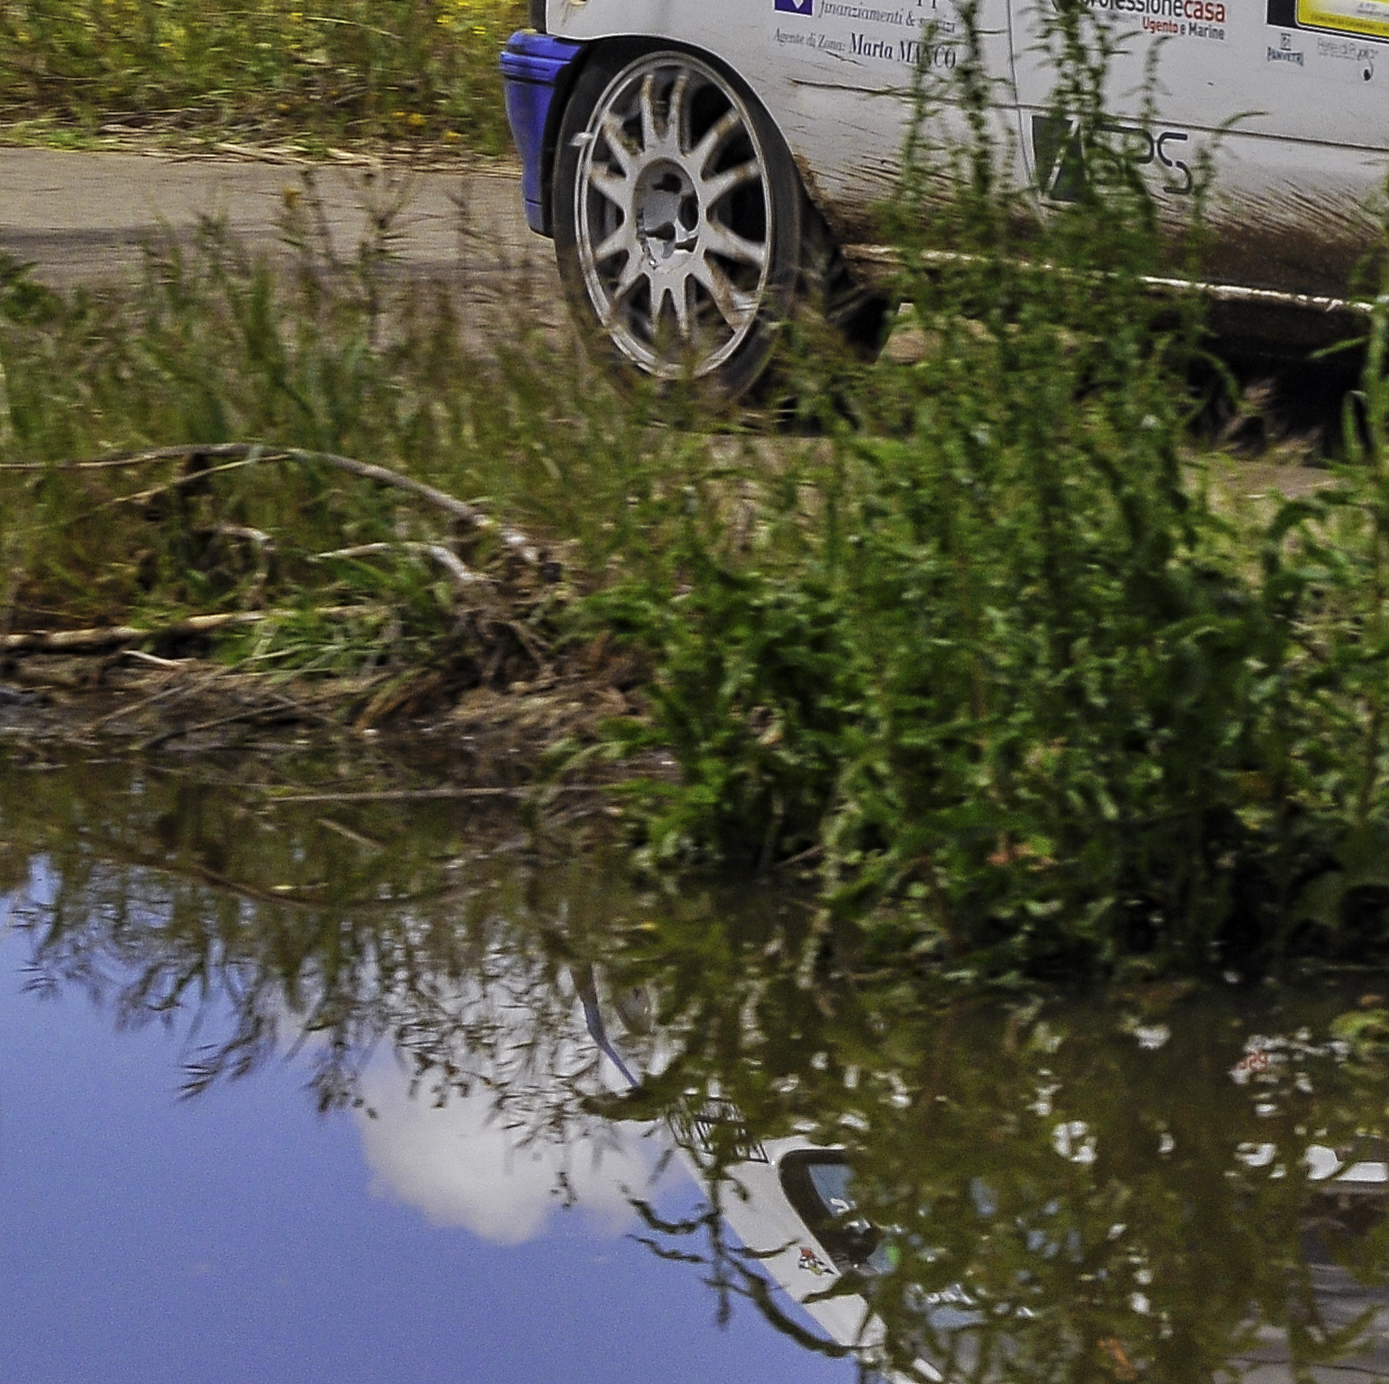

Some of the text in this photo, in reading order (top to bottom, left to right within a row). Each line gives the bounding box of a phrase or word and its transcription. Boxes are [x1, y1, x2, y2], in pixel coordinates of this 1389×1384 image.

[773, 27, 805, 47] Agente
[1142, 16, 1225, 41] Ugento e Marine
[848, 31, 893, 60] Marta
